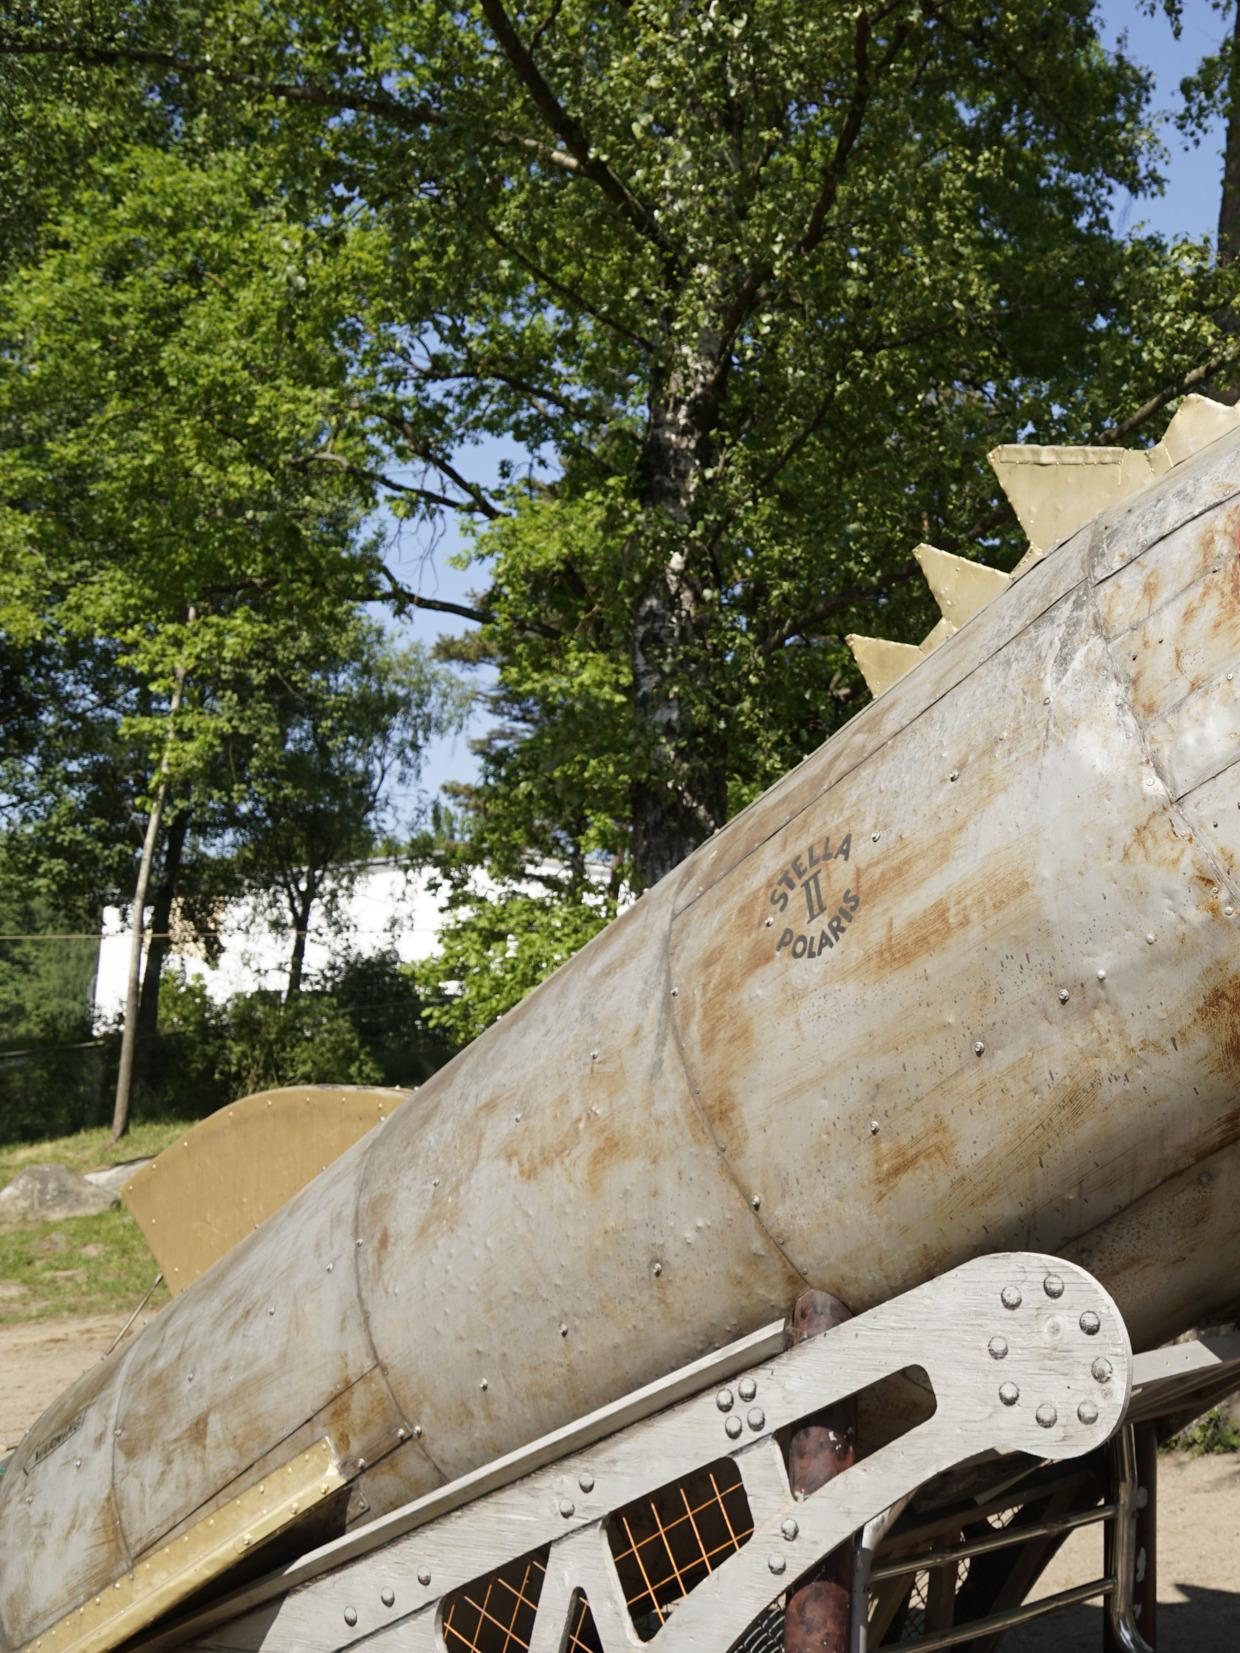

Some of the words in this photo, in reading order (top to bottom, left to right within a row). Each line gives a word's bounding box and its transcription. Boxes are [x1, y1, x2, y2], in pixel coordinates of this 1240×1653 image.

[770, 833, 852, 912] STELLA
[800, 868, 827, 925] II
[776, 888, 861, 959] POLARIS
